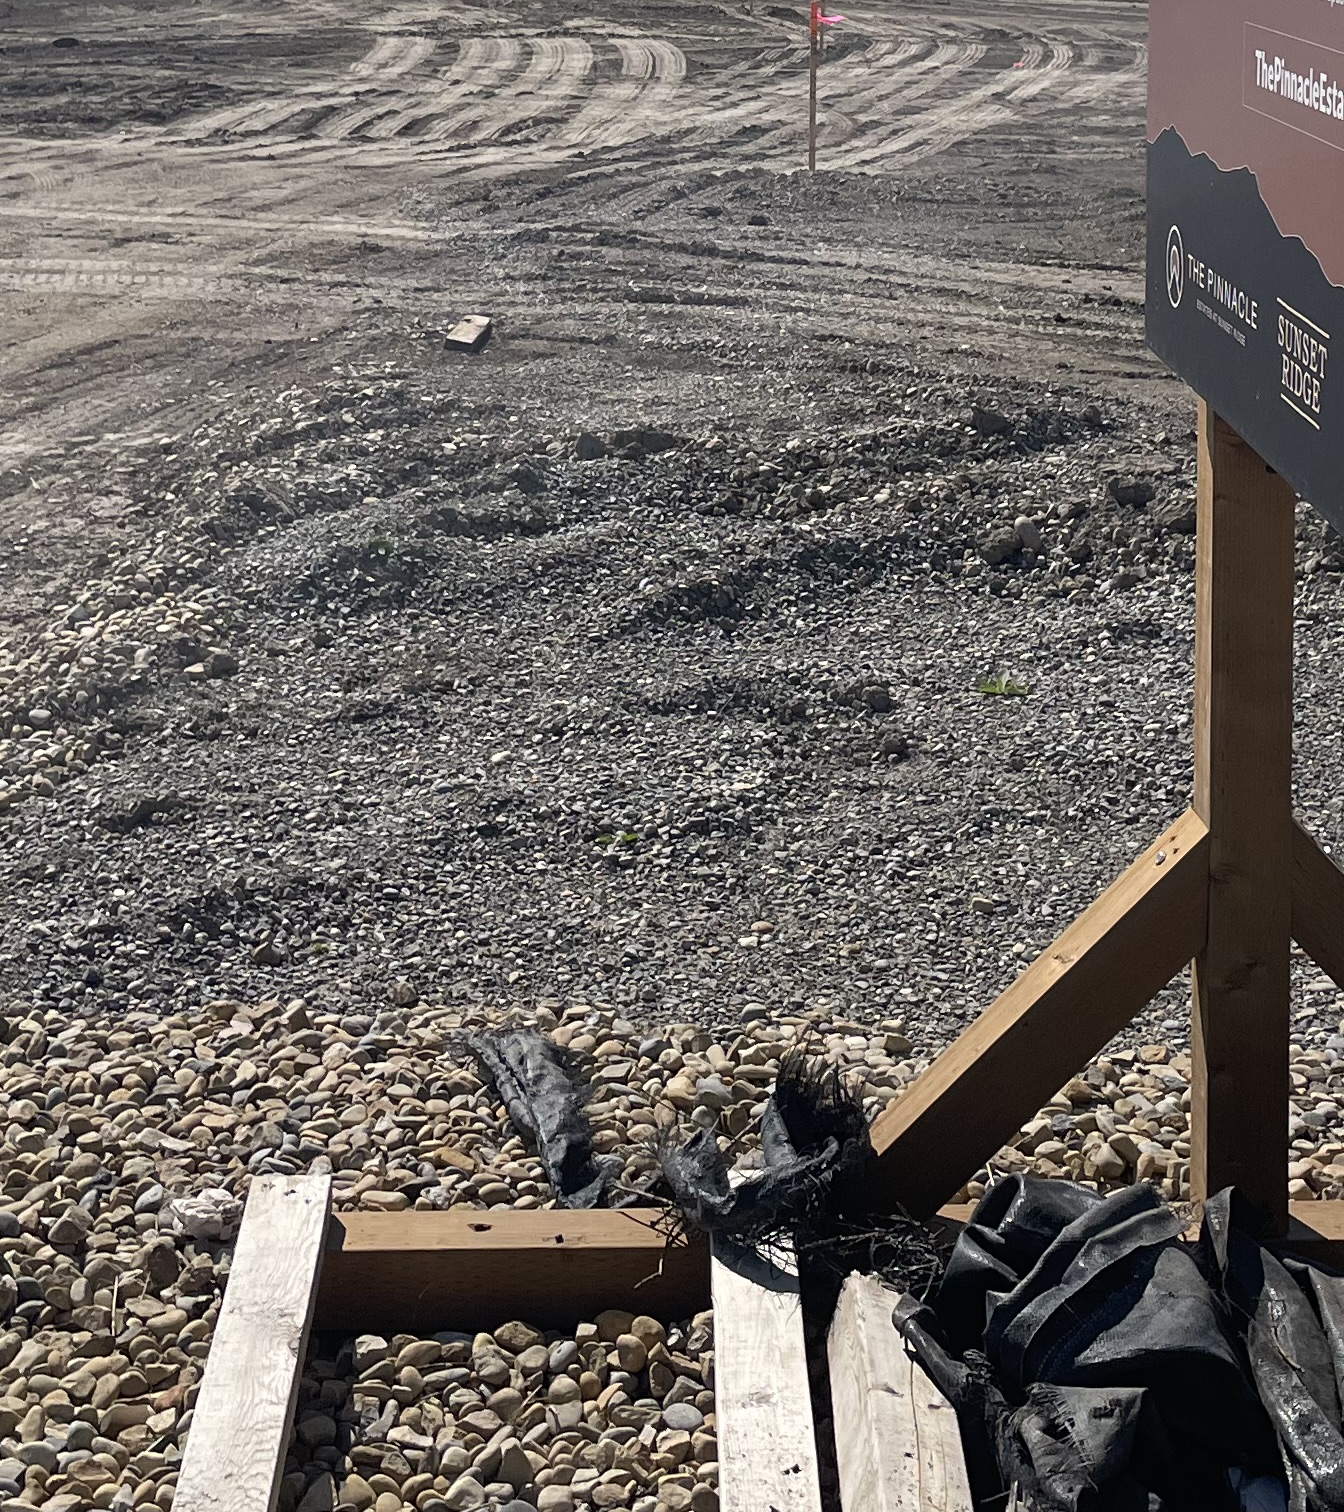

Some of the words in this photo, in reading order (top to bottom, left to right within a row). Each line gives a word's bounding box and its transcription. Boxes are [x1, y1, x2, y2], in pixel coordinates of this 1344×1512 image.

[1187, 253, 1204, 288] THE
[1207, 268, 1257, 329] PINNACLE
[1277, 314, 1327, 378] SUNSET
[1281, 353, 1320, 413] RIDGE
